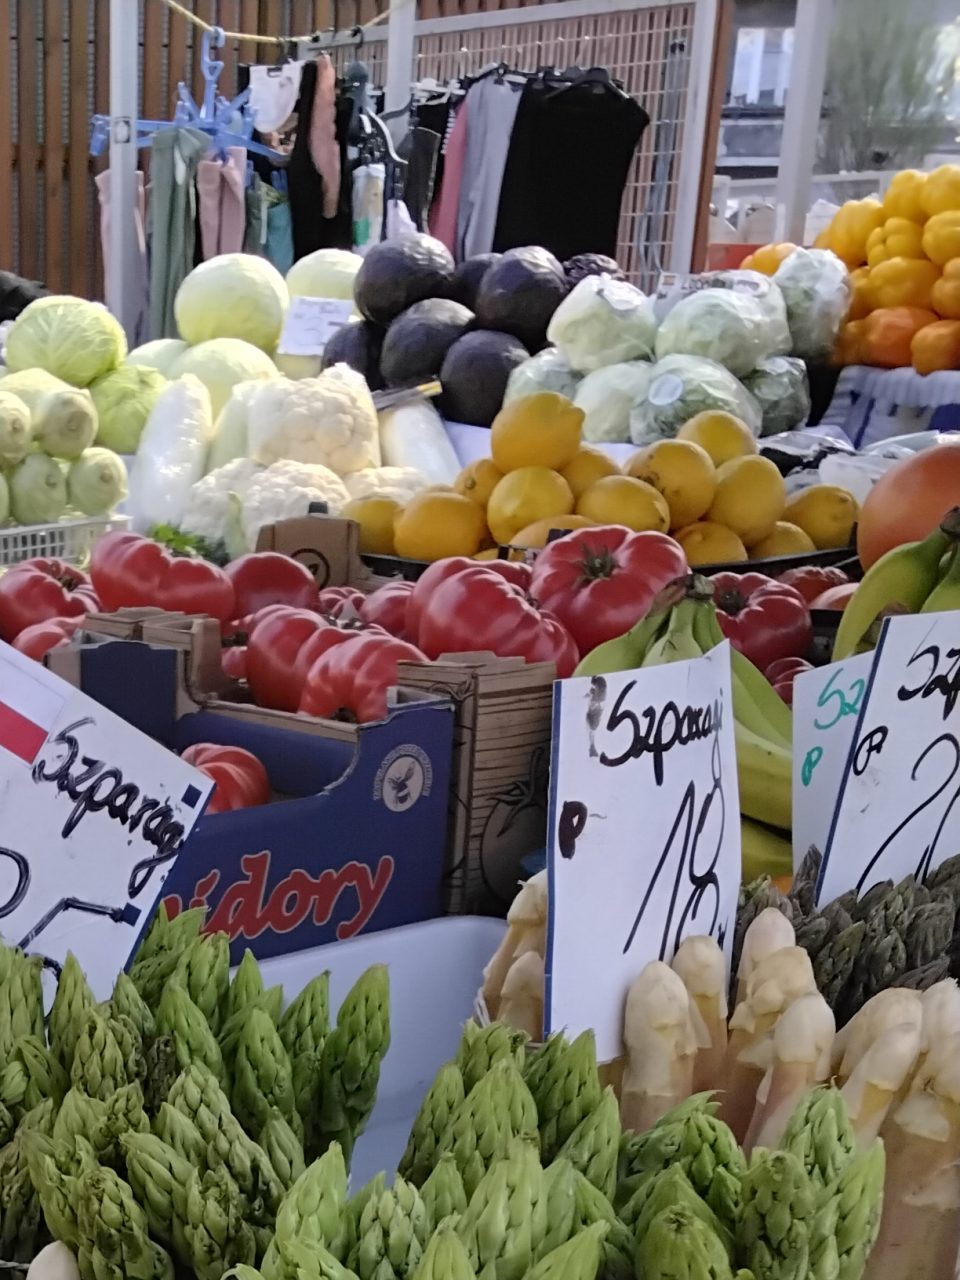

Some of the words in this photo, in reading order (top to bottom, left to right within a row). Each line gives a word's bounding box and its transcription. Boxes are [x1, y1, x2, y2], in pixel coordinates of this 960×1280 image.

[557, 800, 588, 860] P
[623, 780, 726, 962] 18
[162, 850, 395, 941] idory
